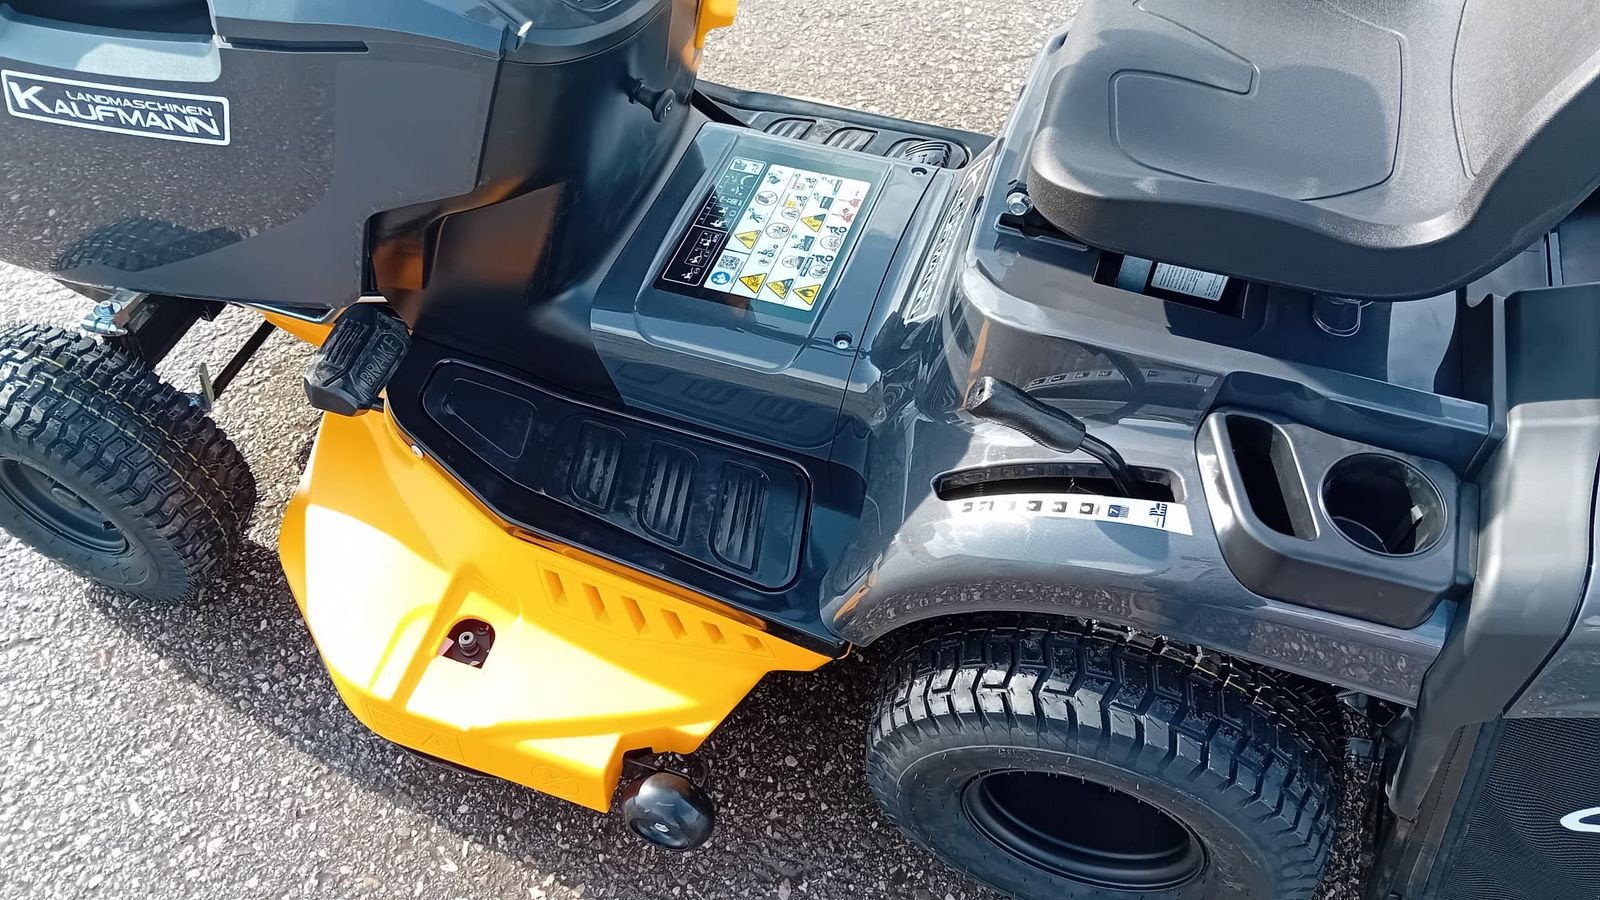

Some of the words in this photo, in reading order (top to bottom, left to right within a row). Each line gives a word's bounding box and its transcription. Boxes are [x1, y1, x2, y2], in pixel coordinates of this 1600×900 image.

[8, 81, 221, 136] KAUFMANN
[65, 90, 213, 117] LANDMASCHINEN
[359, 335, 401, 386] BRAKE
